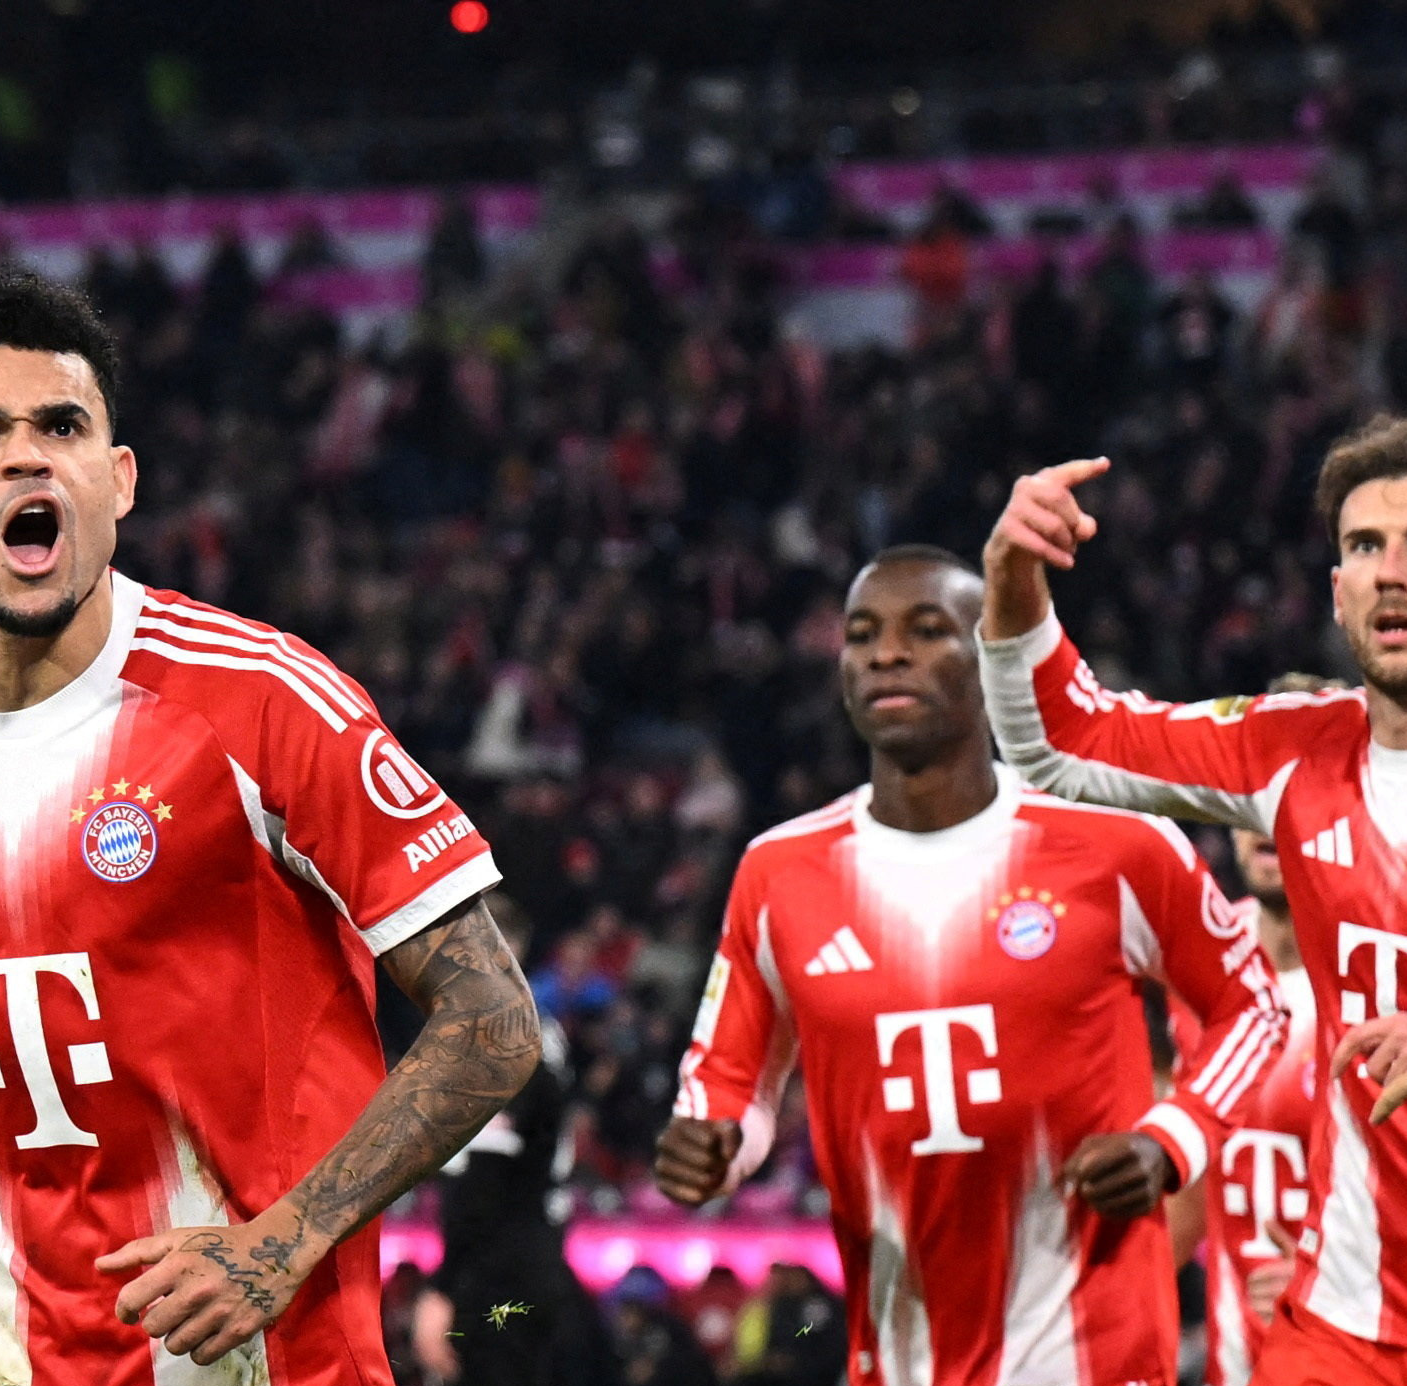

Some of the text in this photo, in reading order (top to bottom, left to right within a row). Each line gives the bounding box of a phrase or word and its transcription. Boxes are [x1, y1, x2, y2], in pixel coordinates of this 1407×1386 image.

[88, 807, 151, 838] FC BAYERN
[874, 1003, 1003, 1157] T
[1221, 1127, 1310, 1258] T
